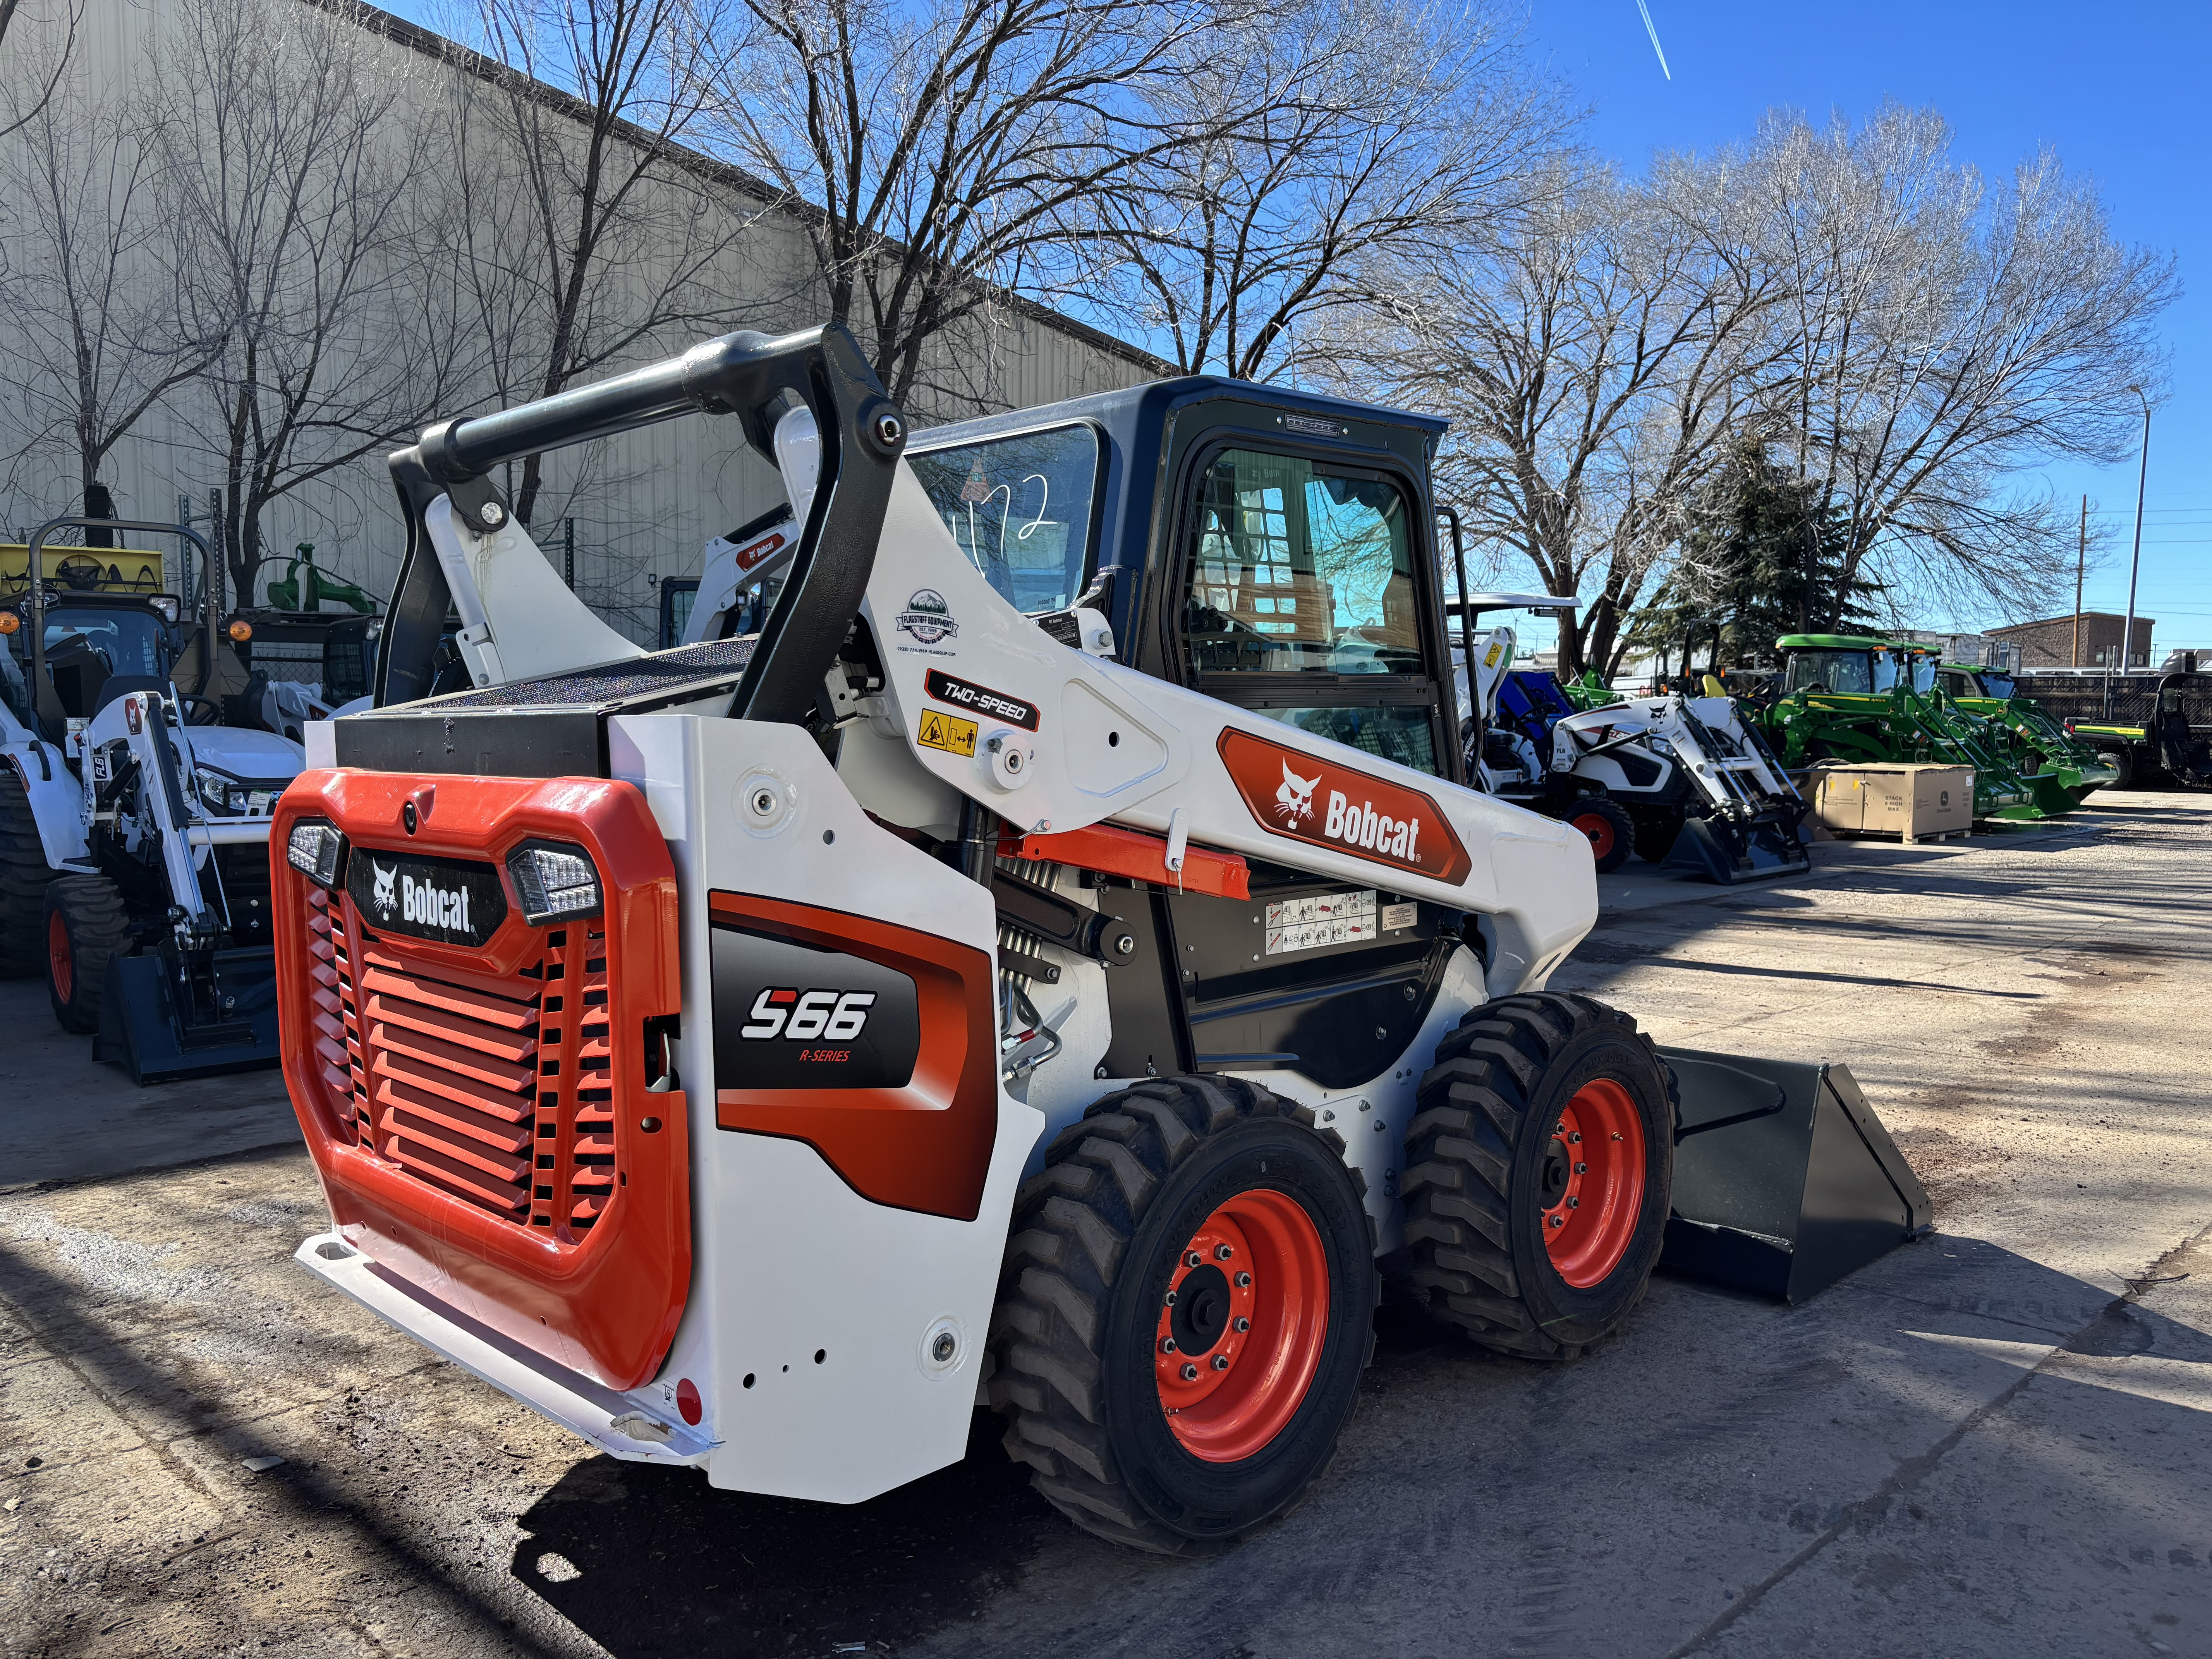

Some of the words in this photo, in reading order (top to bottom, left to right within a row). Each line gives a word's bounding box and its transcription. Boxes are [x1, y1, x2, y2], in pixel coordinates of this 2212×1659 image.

[757, 540, 774, 558] Bobcat
[903, 615, 927, 624] FLAGSTAFF
[928, 616, 953, 629] EQUIPMENT
[945, 682, 1027, 720] TWO-SPEED
[94, 757, 106, 777] FL8
[1324, 790, 1419, 862] Bobcat
[402, 875, 470, 933] Bobcat
[740, 989, 876, 1040] S66
[799, 1049, 850, 1062] R-SERIES
